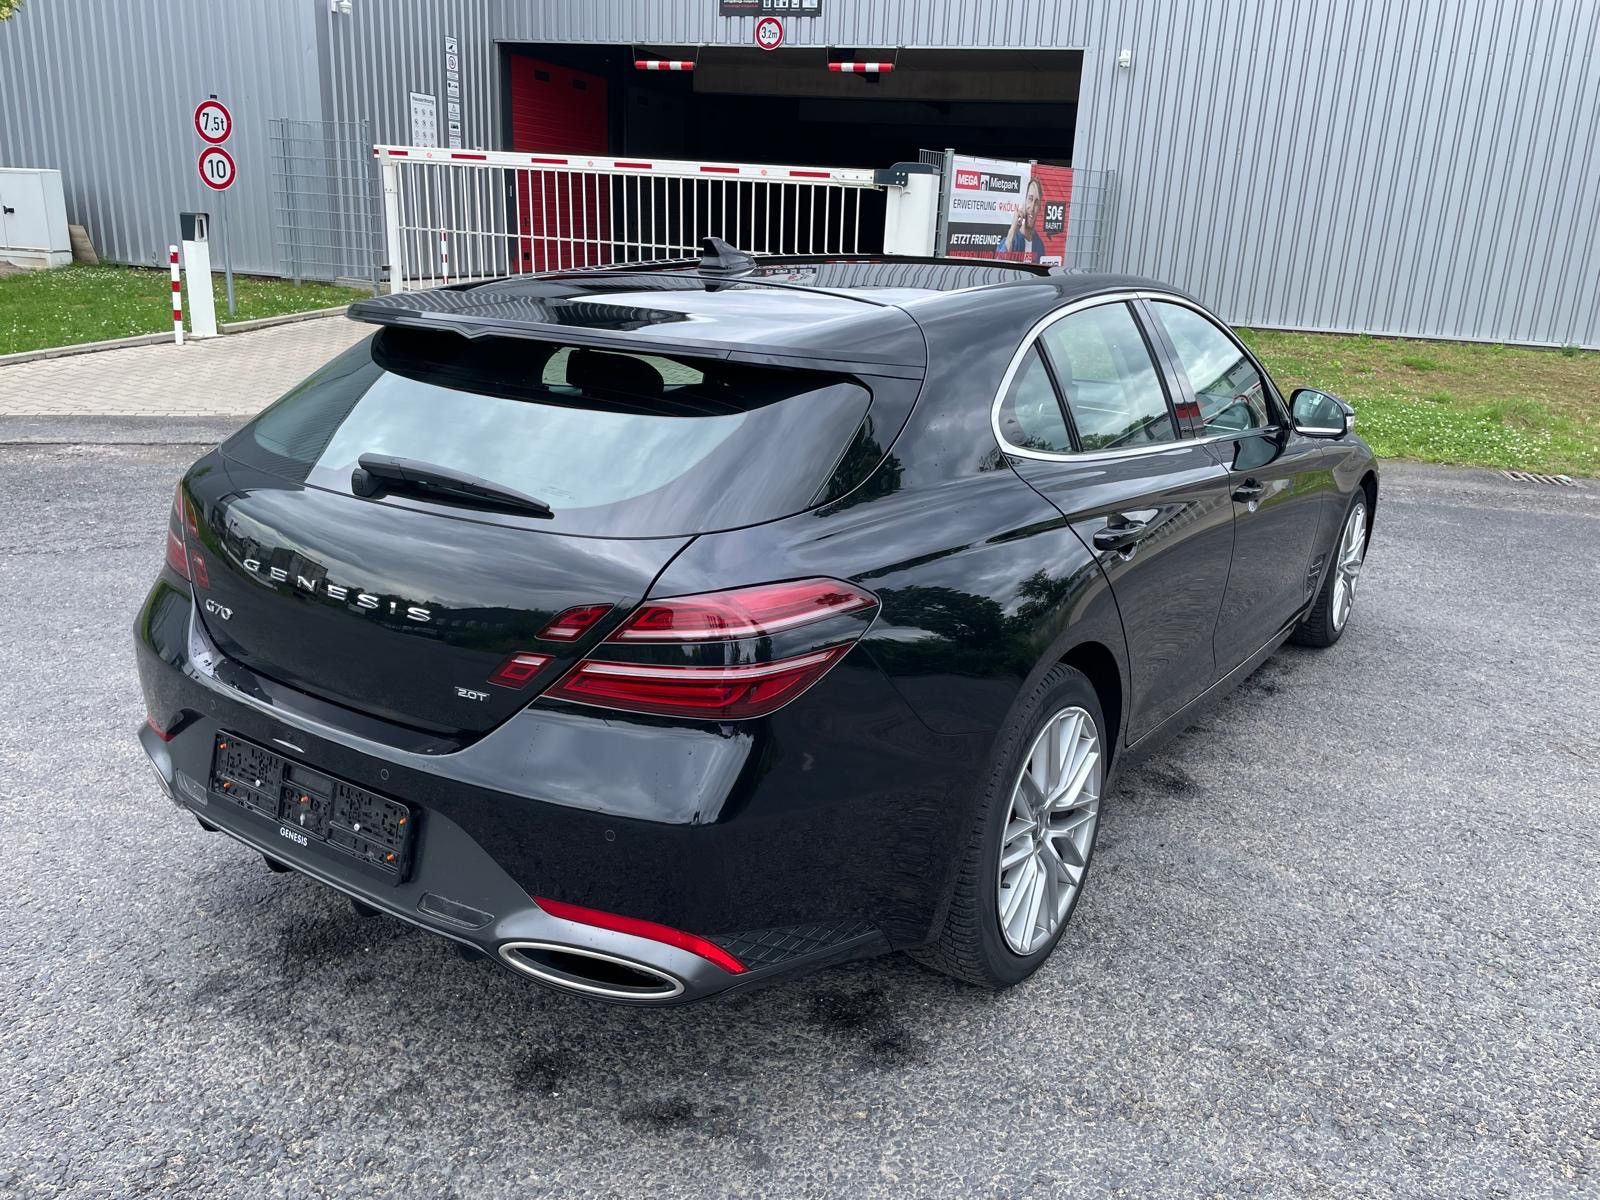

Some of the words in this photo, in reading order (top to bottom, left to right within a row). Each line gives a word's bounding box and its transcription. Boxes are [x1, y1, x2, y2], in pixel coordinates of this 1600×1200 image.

[208, 160, 227, 179] 10
[957, 174, 978, 187] MEGA
[990, 177, 1019, 191] Mietpark
[953, 199, 997, 211] ERWEITERUNG
[1046, 205, 1063, 220] 50€
[950, 234, 971, 245] JETZT
[970, 234, 1002, 246] FREUNDE
[242, 558, 432, 623] GENESIS
[205, 598, 233, 621] G70
[279, 826, 308, 847] GENESIS
